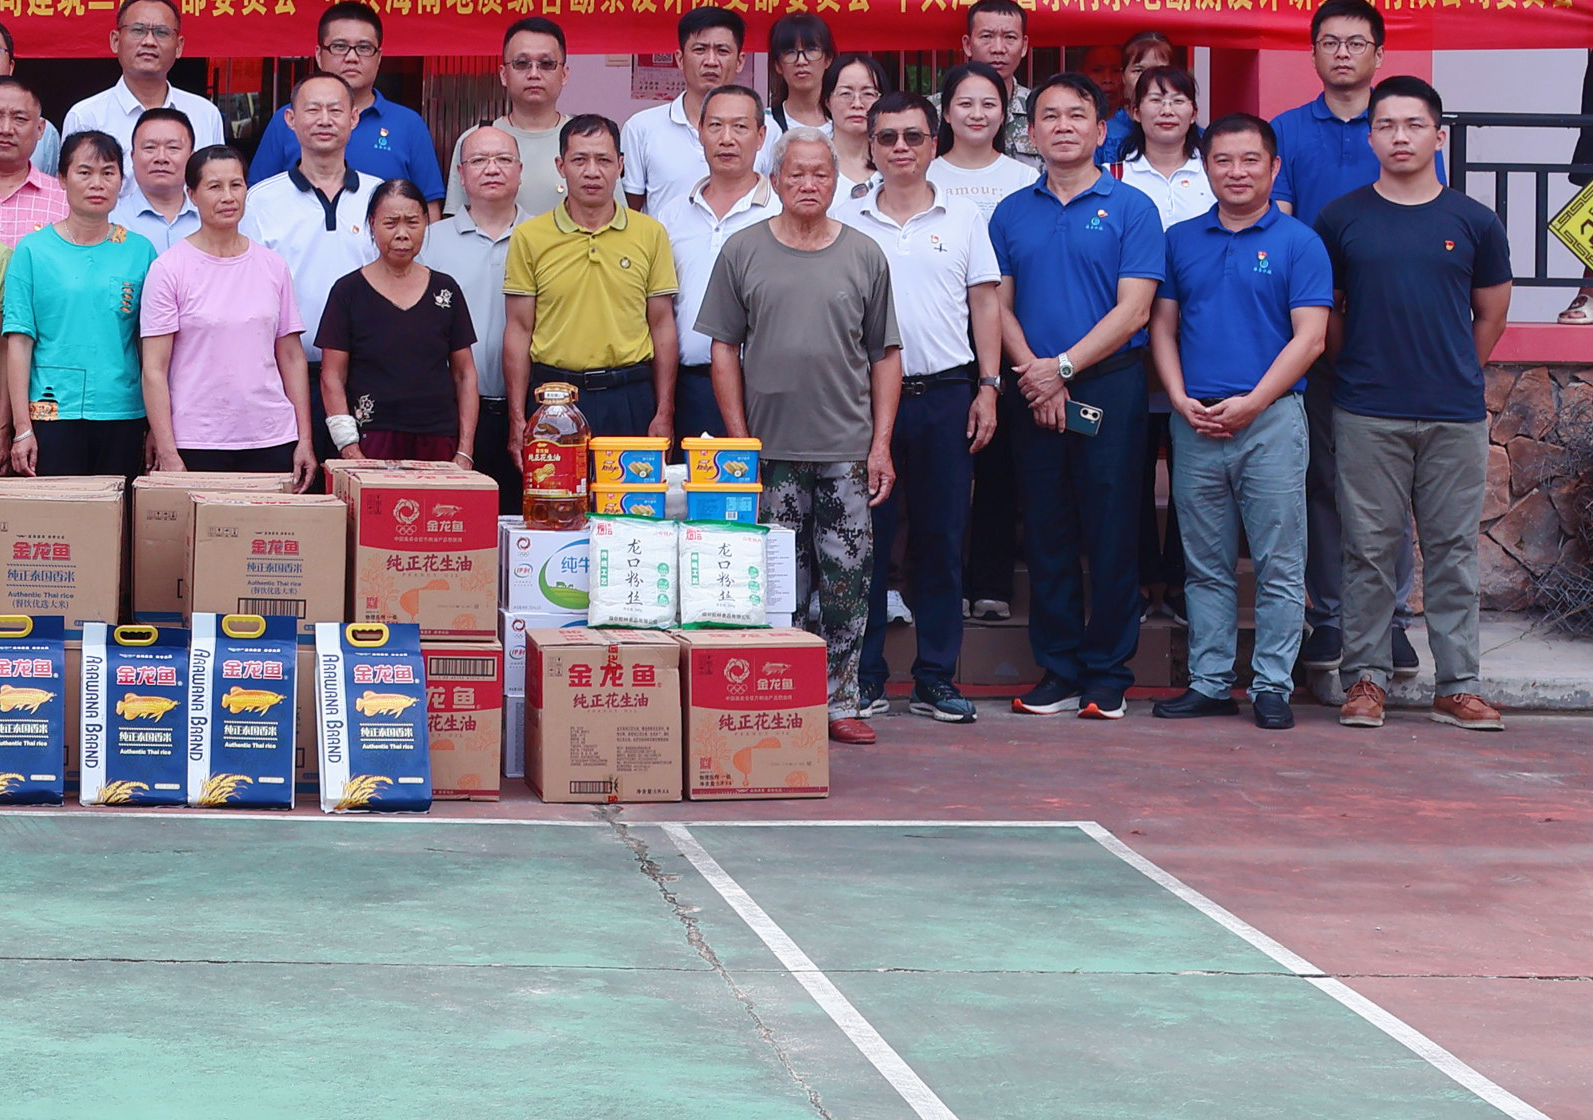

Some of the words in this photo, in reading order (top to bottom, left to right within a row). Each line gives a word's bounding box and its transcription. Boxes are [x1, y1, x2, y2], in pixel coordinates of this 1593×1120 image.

[427, 520, 464, 533] 金龙鱼
[12, 541, 71, 560] 金龙鱼
[251, 540, 299, 556] 金龙鱼
[386, 554, 473, 572] 纯正花生油
[625, 538, 644, 606] 龙口粉丝
[716, 542, 735, 602] 龙口粉丝
[116, 666, 177, 686] 金龙鱼
[191, 648, 211, 712] ARAWANA
[222, 660, 283, 680] 金龙鱼
[354, 664, 414, 684] 金龙鱼
[568, 664, 656, 687] 金龙鱼
[85, 655, 103, 719] ARAWANA
[323, 654, 340, 715] ARAWANA
[757, 678, 794, 690] 金龙鱼
[573, 692, 649, 709] 纯正花生油
[718, 712, 803, 731] 纯正花生油
[85, 723, 103, 769] BRAND
[190, 716, 208, 761] BRAND
[326, 720, 344, 764] BRAND
